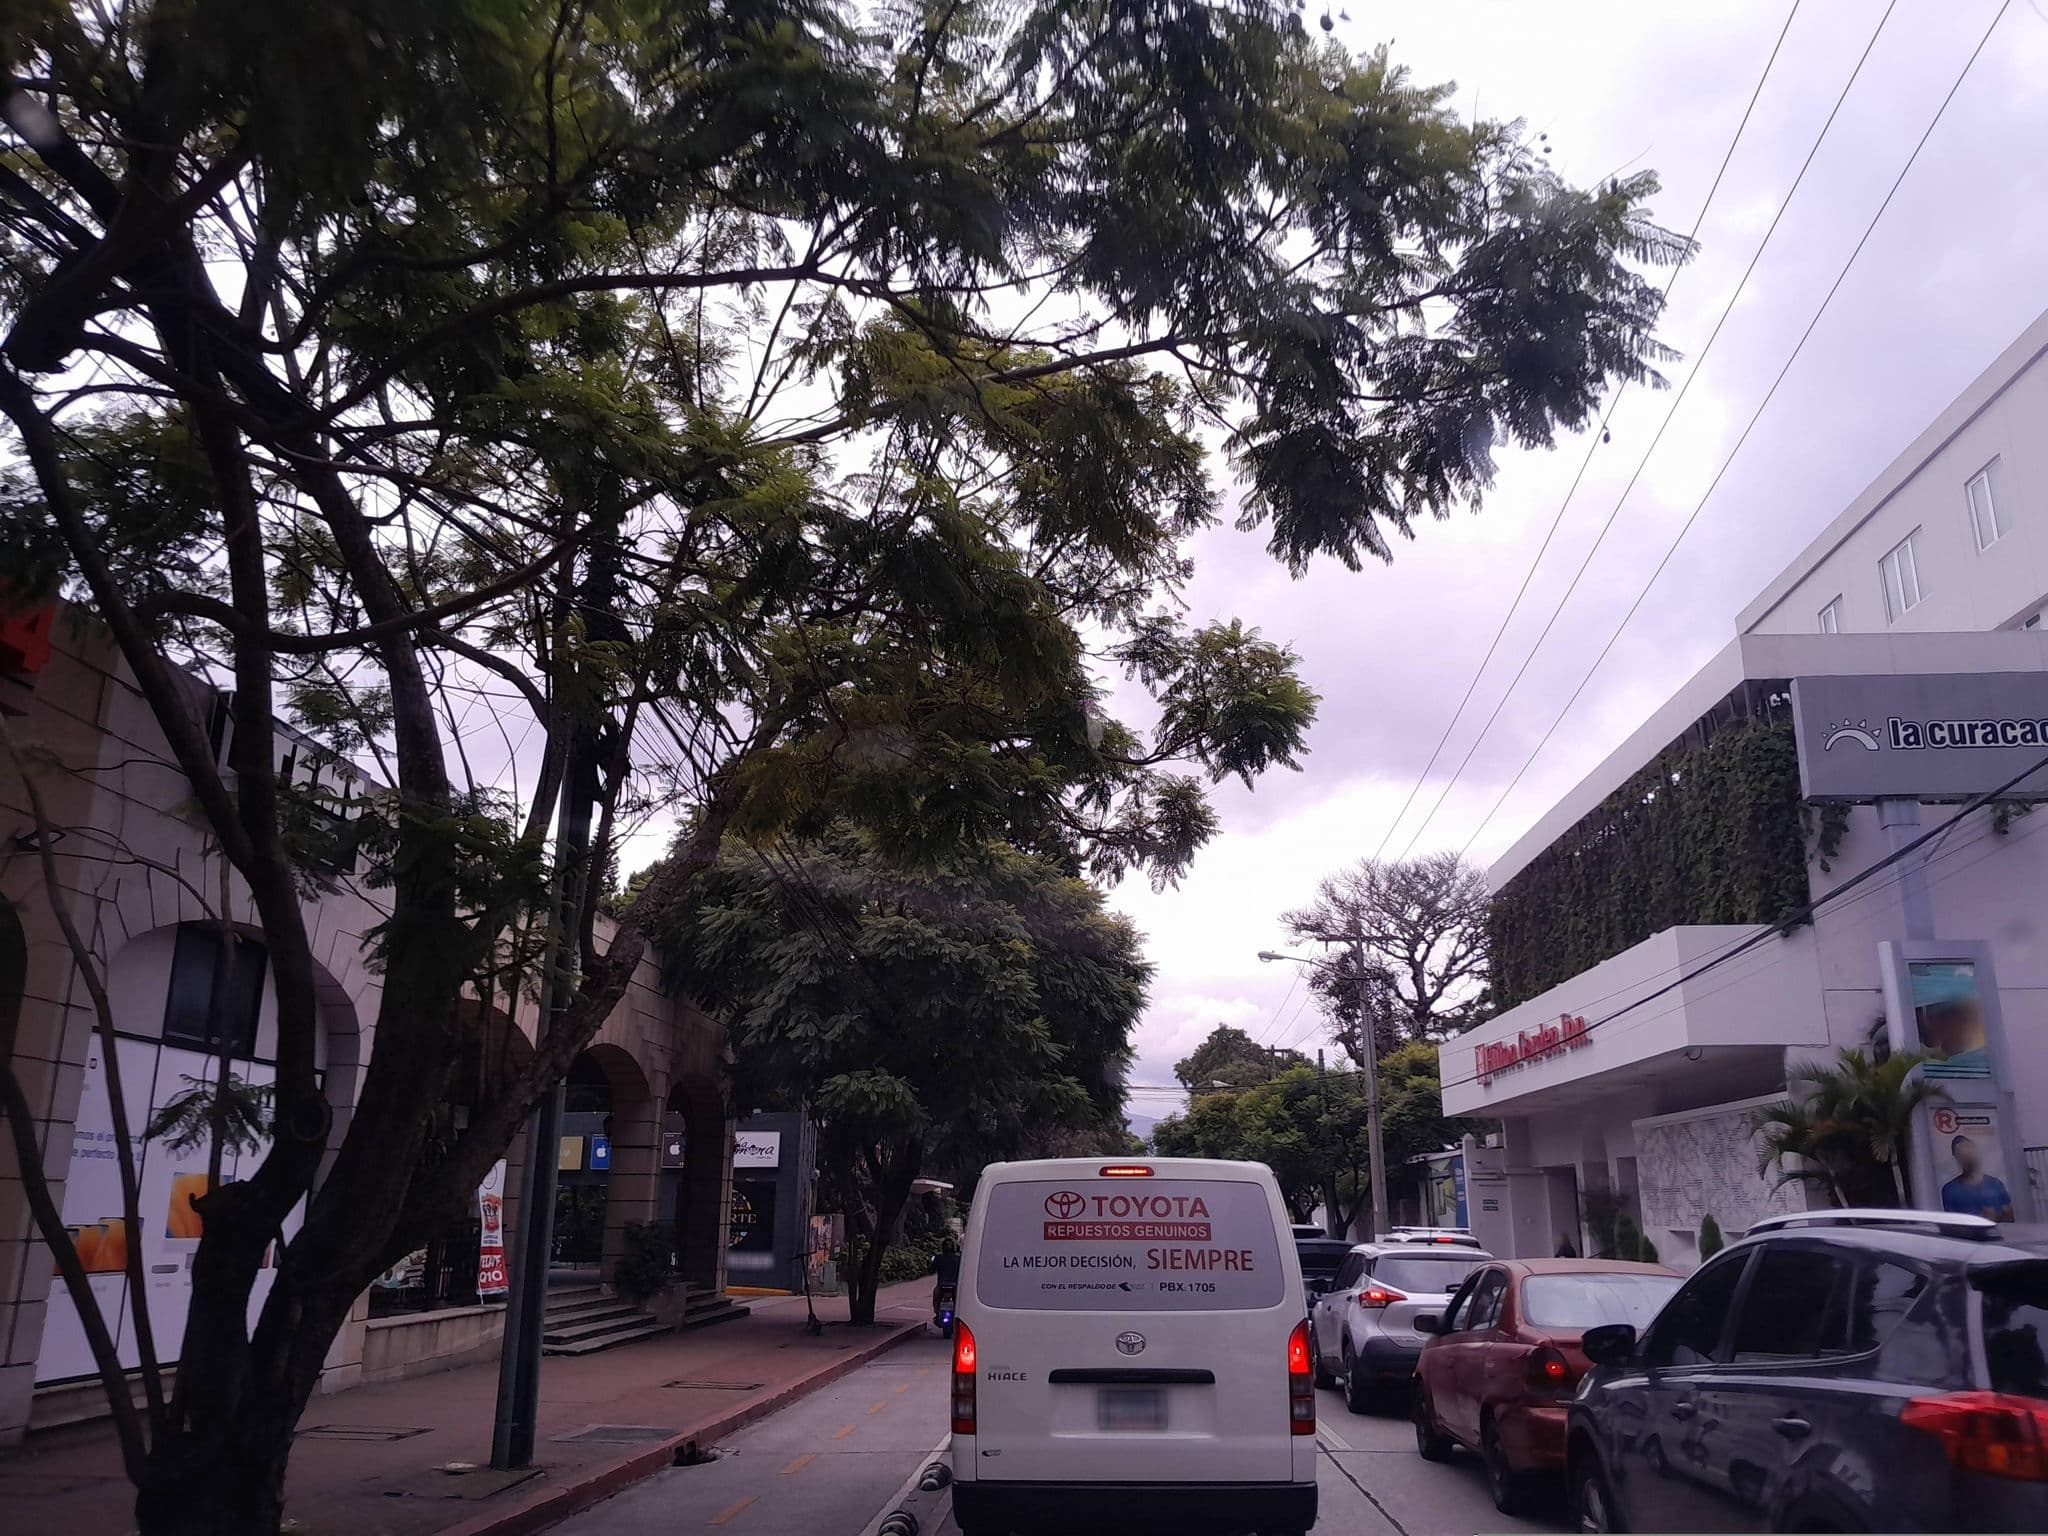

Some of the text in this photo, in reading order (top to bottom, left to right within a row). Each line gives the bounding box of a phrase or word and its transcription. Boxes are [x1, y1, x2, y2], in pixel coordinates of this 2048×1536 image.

[1889, 718, 1923, 748] la
[1091, 1195, 1210, 1218] TOYOTA
[1047, 1224, 1207, 1238] REPUESTOS GENUINOS
[1003, 1248, 1254, 1271] LA MEJOR DECISIÓN, SIEMPRE
[1159, 1282, 1216, 1293] PBX 1705
[988, 1372, 1027, 1381] HIACE
